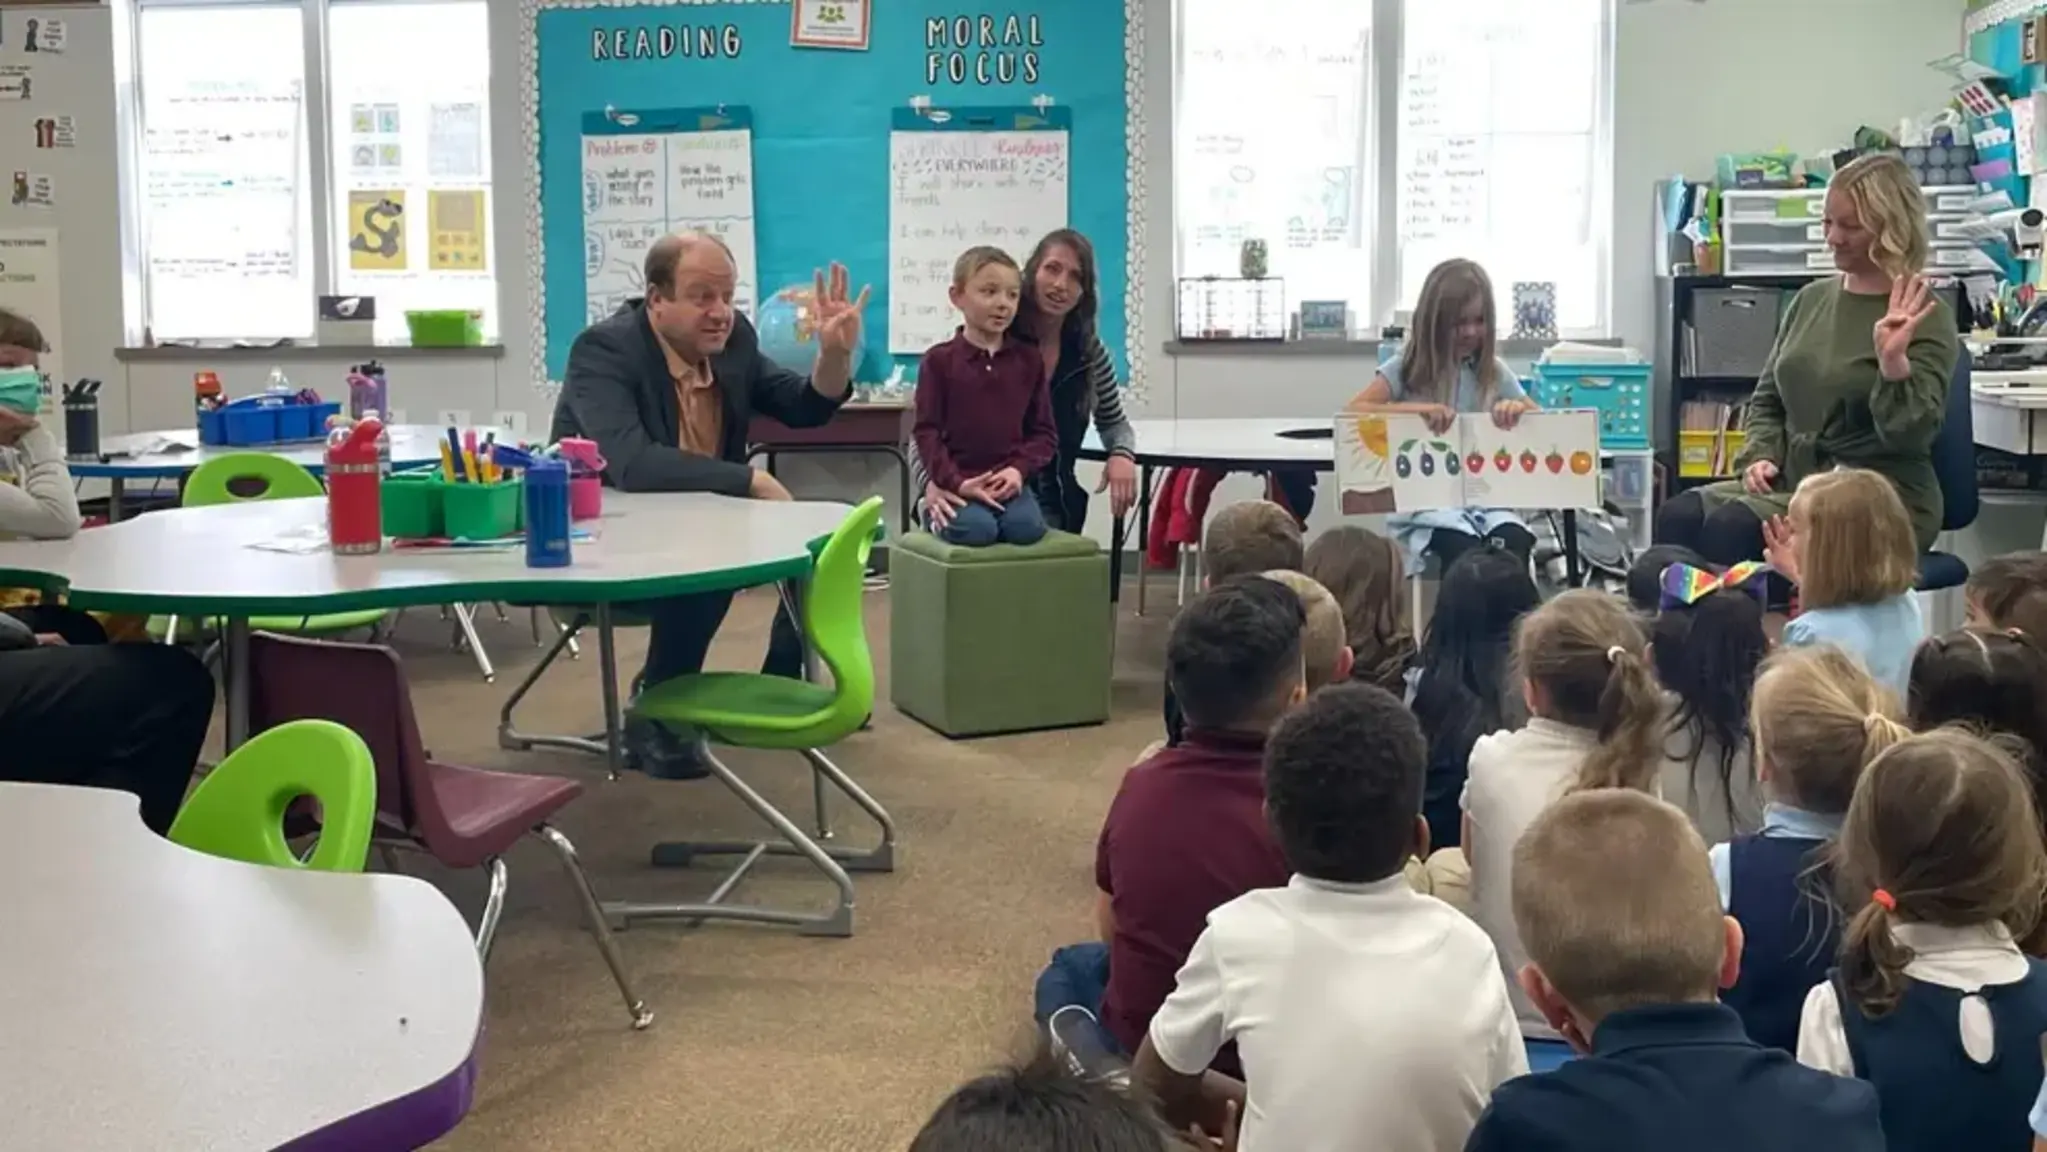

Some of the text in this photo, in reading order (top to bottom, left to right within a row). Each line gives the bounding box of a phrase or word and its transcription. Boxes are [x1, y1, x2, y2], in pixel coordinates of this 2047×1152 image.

[592, 25, 742, 60] READING
[926, 14, 1044, 49] MORAL
[926, 50, 1039, 85] FOCUS
[503, 415, 513, 430] 4
